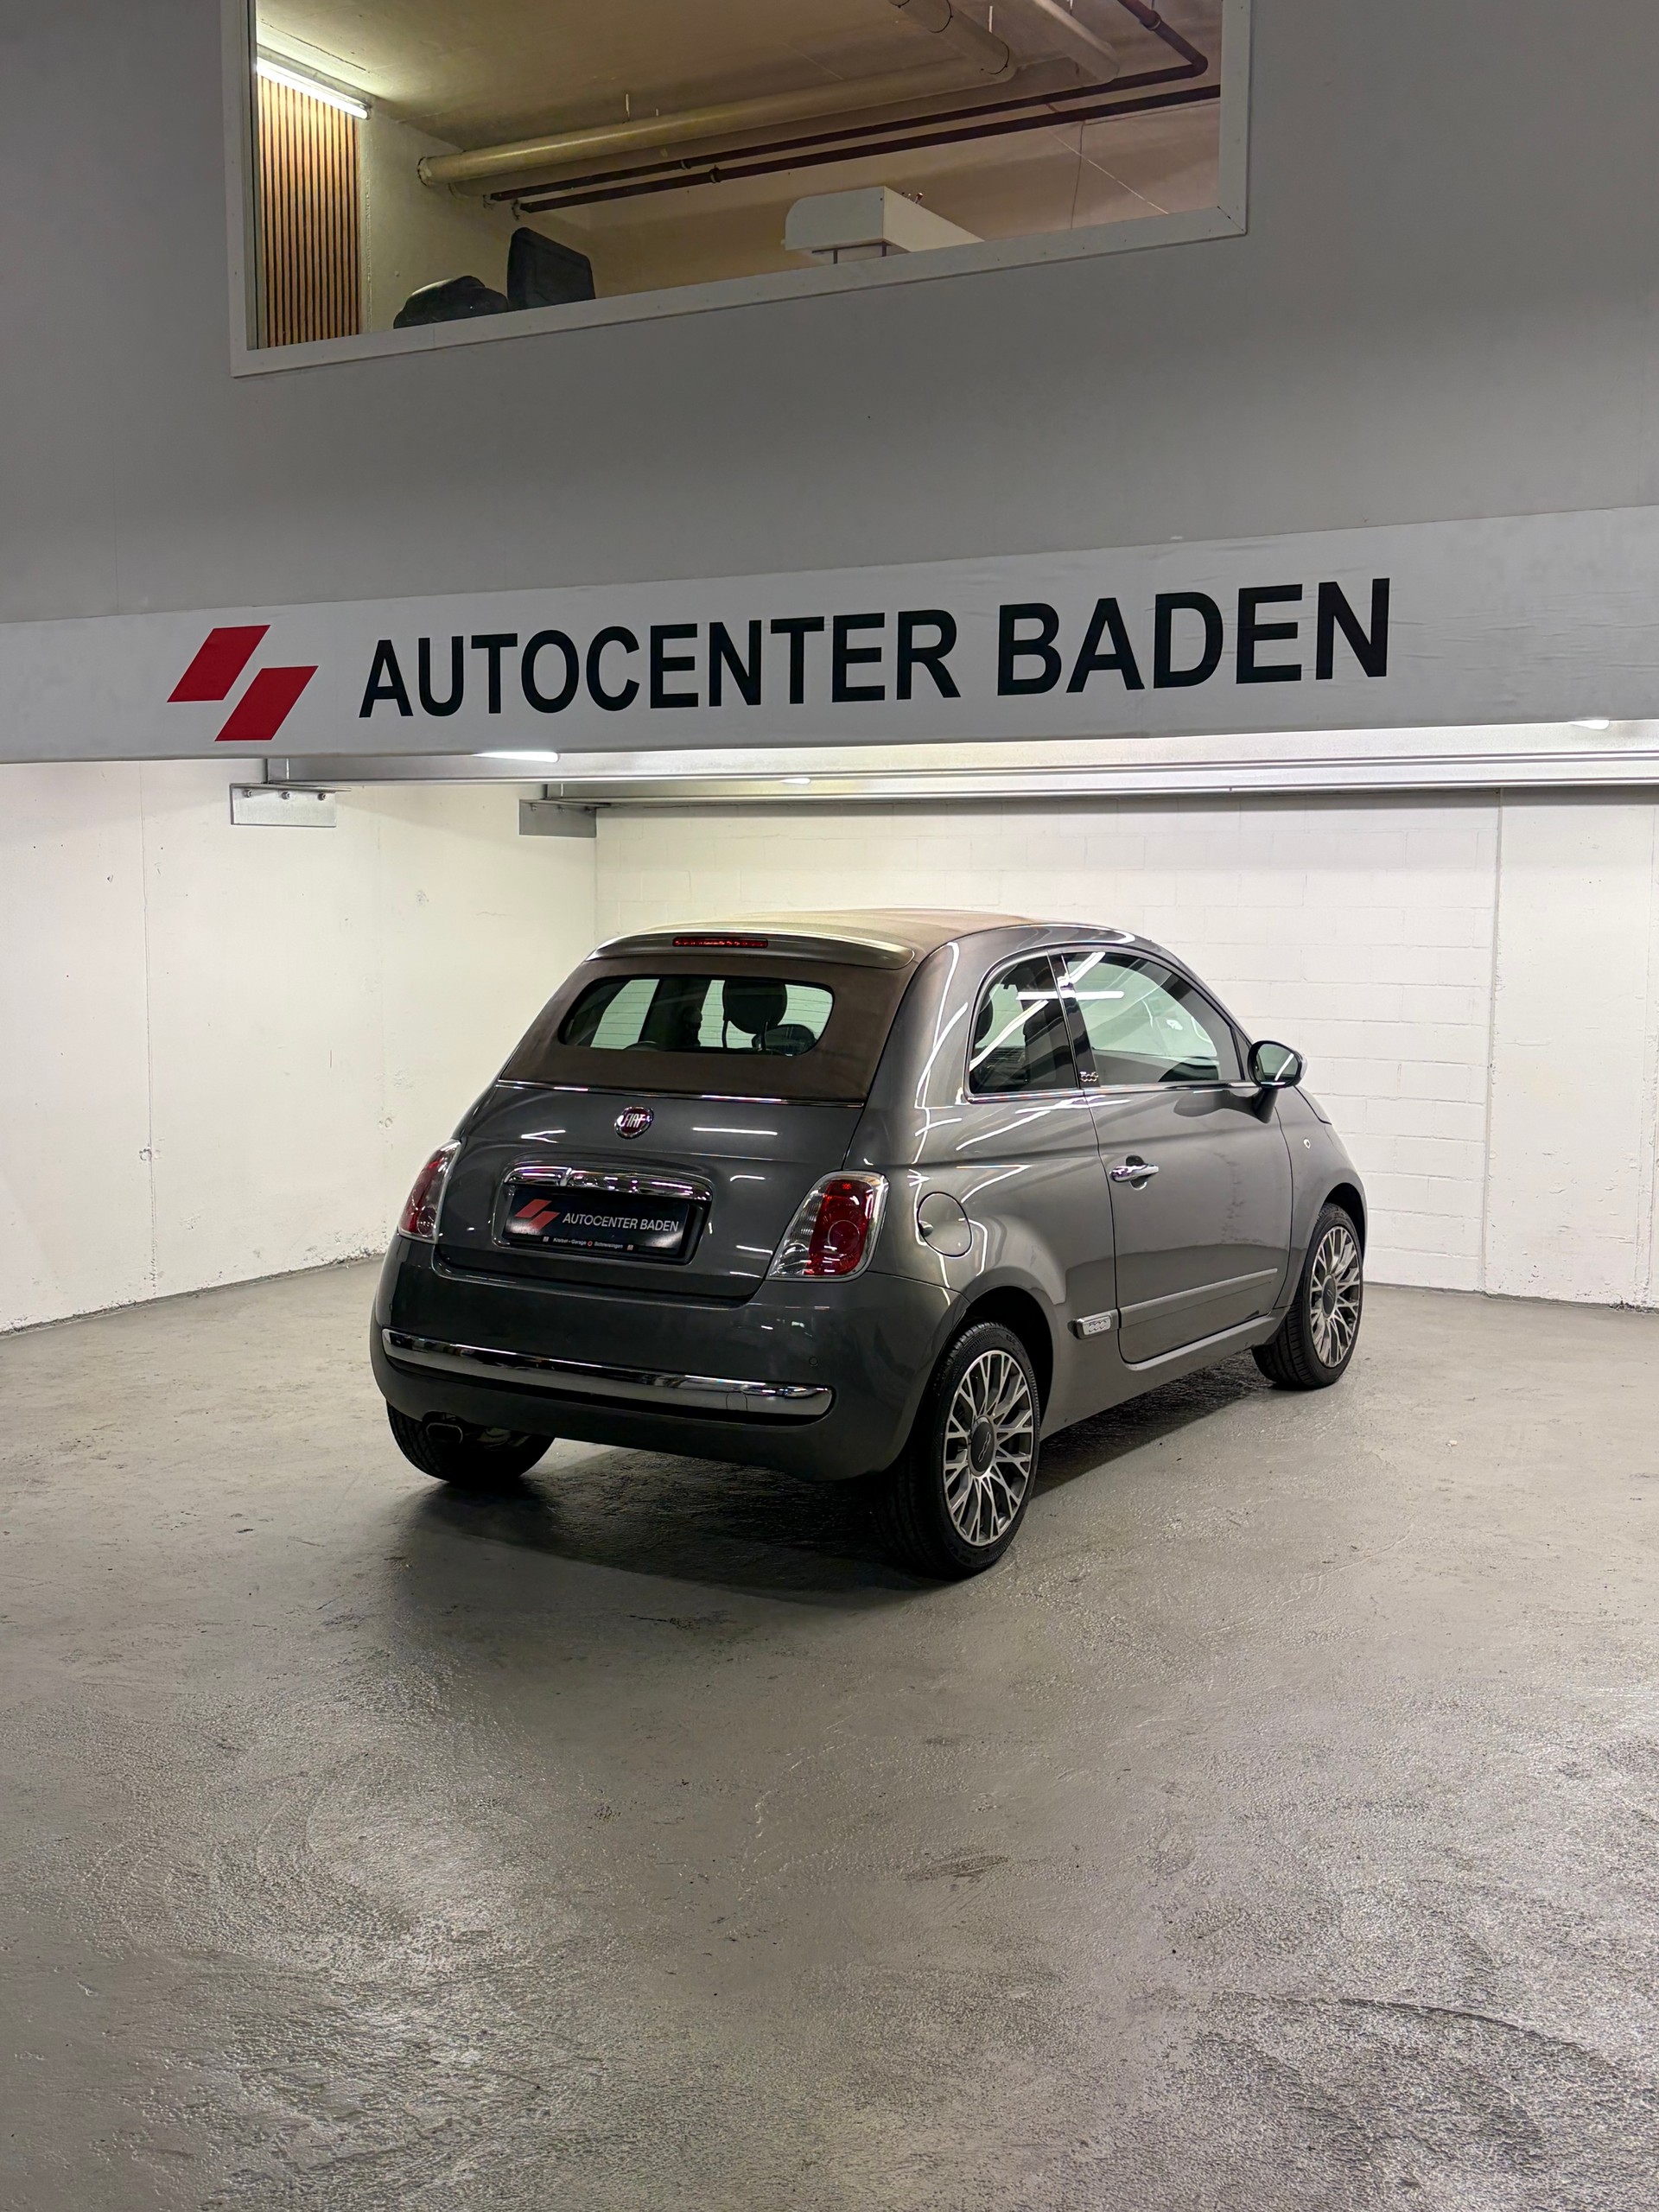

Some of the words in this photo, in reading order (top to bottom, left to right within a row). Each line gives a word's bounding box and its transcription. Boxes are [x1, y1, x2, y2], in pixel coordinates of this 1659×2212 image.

[359, 609, 963, 719] AUTOCENTER
[997, 577, 1391, 696] BADEN
[624, 1112, 645, 1128] FIAT
[562, 1212, 639, 1230] AUTOCENTER
[639, 1218, 679, 1232] BADEN
